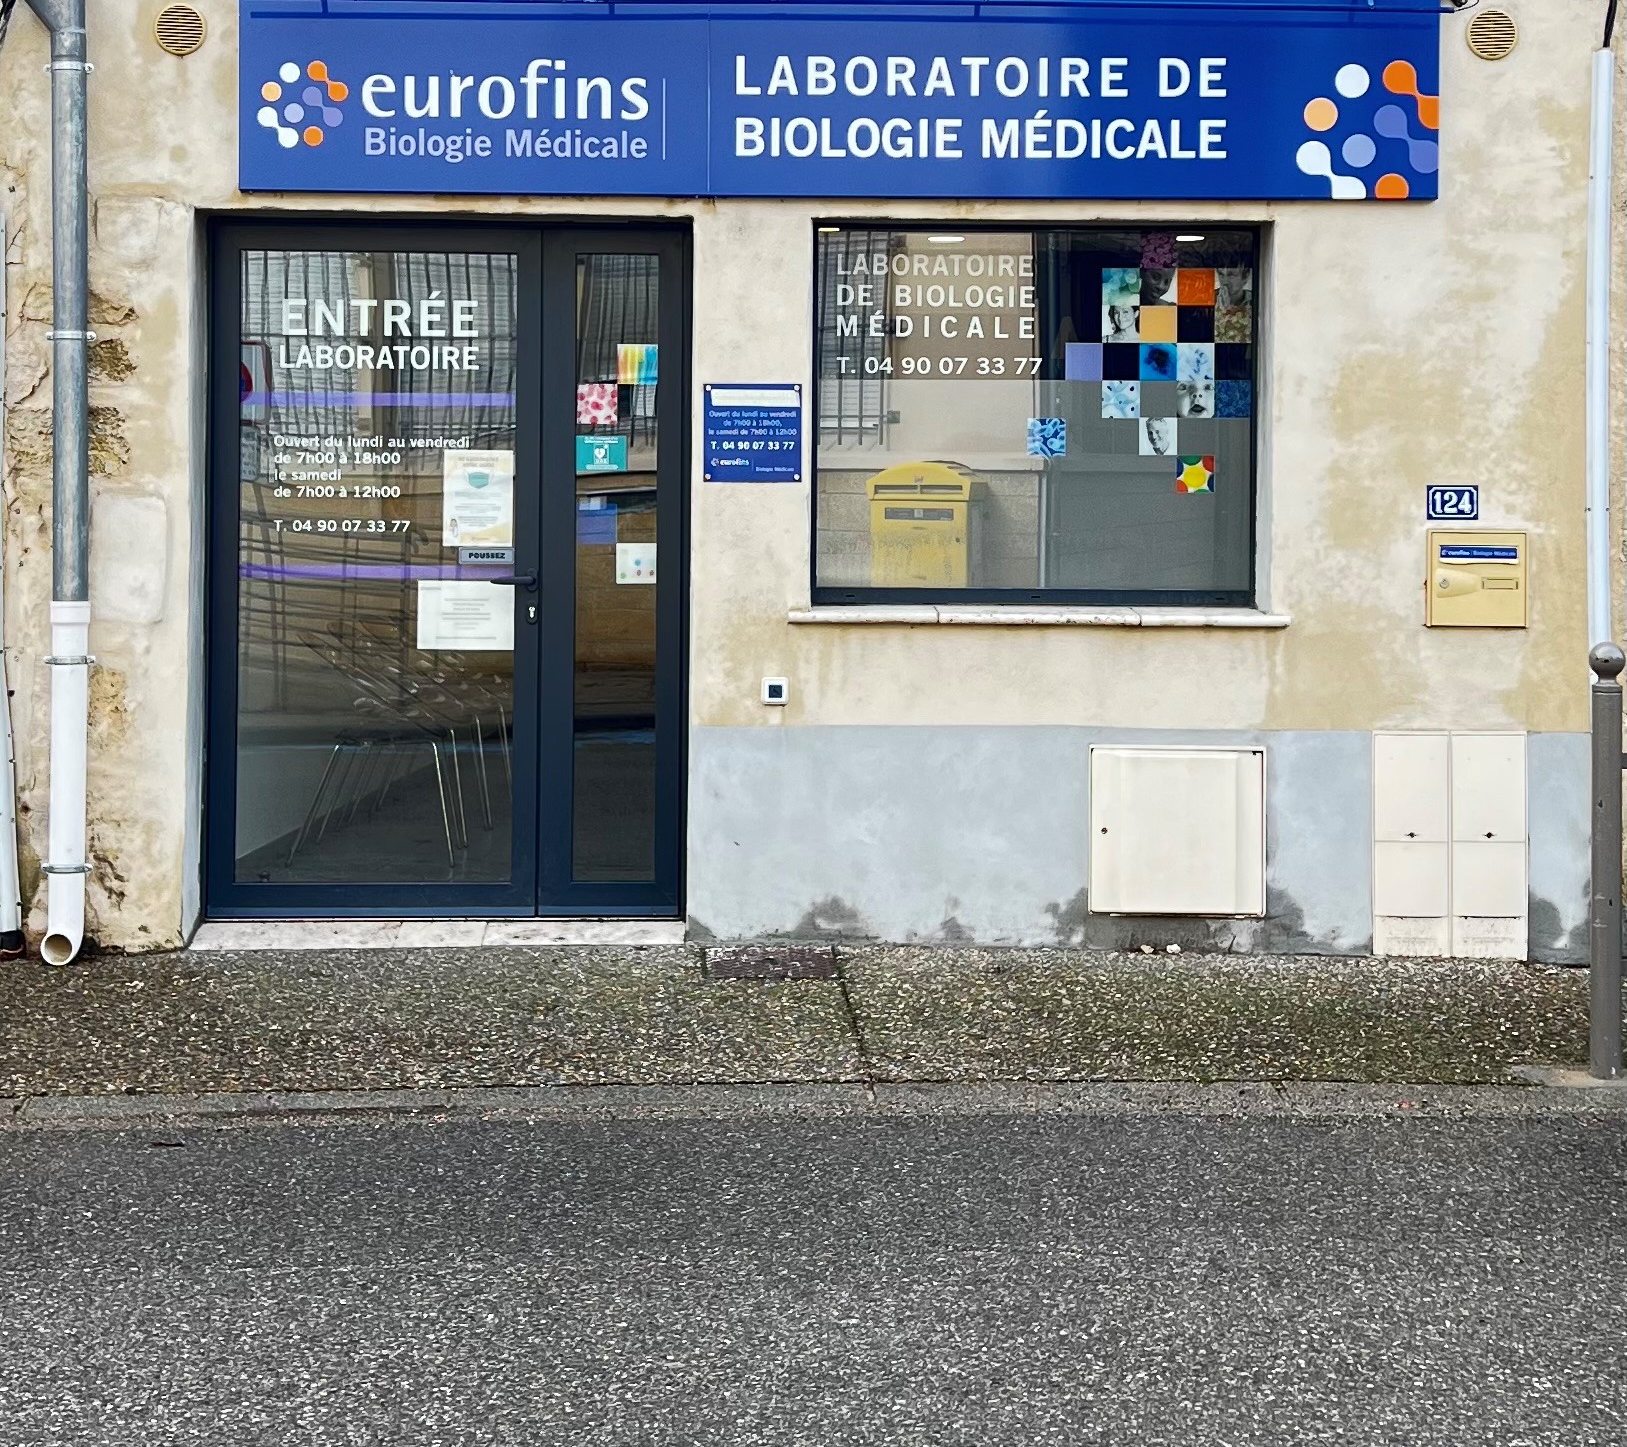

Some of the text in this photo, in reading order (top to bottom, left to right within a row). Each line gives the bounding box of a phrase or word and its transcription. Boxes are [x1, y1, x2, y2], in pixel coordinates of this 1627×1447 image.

[734, 55, 1228, 98] LABORATOIRE DE
[361, 59, 649, 121] eurofins
[364, 127, 649, 163] Biologie Médicale
[735, 110, 1228, 160] BIOLOGIE MÉDICALE
[837, 254, 1034, 277] LABORATOIRE
[837, 284, 1036, 308] DE BIOLOGIE
[281, 290, 479, 337] ENTRÉE
[836, 310, 1035, 339] MÉDICALE
[279, 345, 480, 370] LABORATOIRE
[836, 357, 1043, 375] T. 04 90 07 33 77
[273, 435, 470, 449] Ouvert du lundi au vendredi
[710, 441, 795, 450] T. 04 90 07 33 77
[273, 452, 400, 464] de 7h00 à 18h00
[274, 469, 342, 481] le samedi
[273, 486, 400, 498] de 7h00 à 12h00
[1434, 491, 1472, 514] 124
[273, 520, 411, 533] T. 04 90 07 33 77
[468, 552, 506, 560] POUSSEZ
